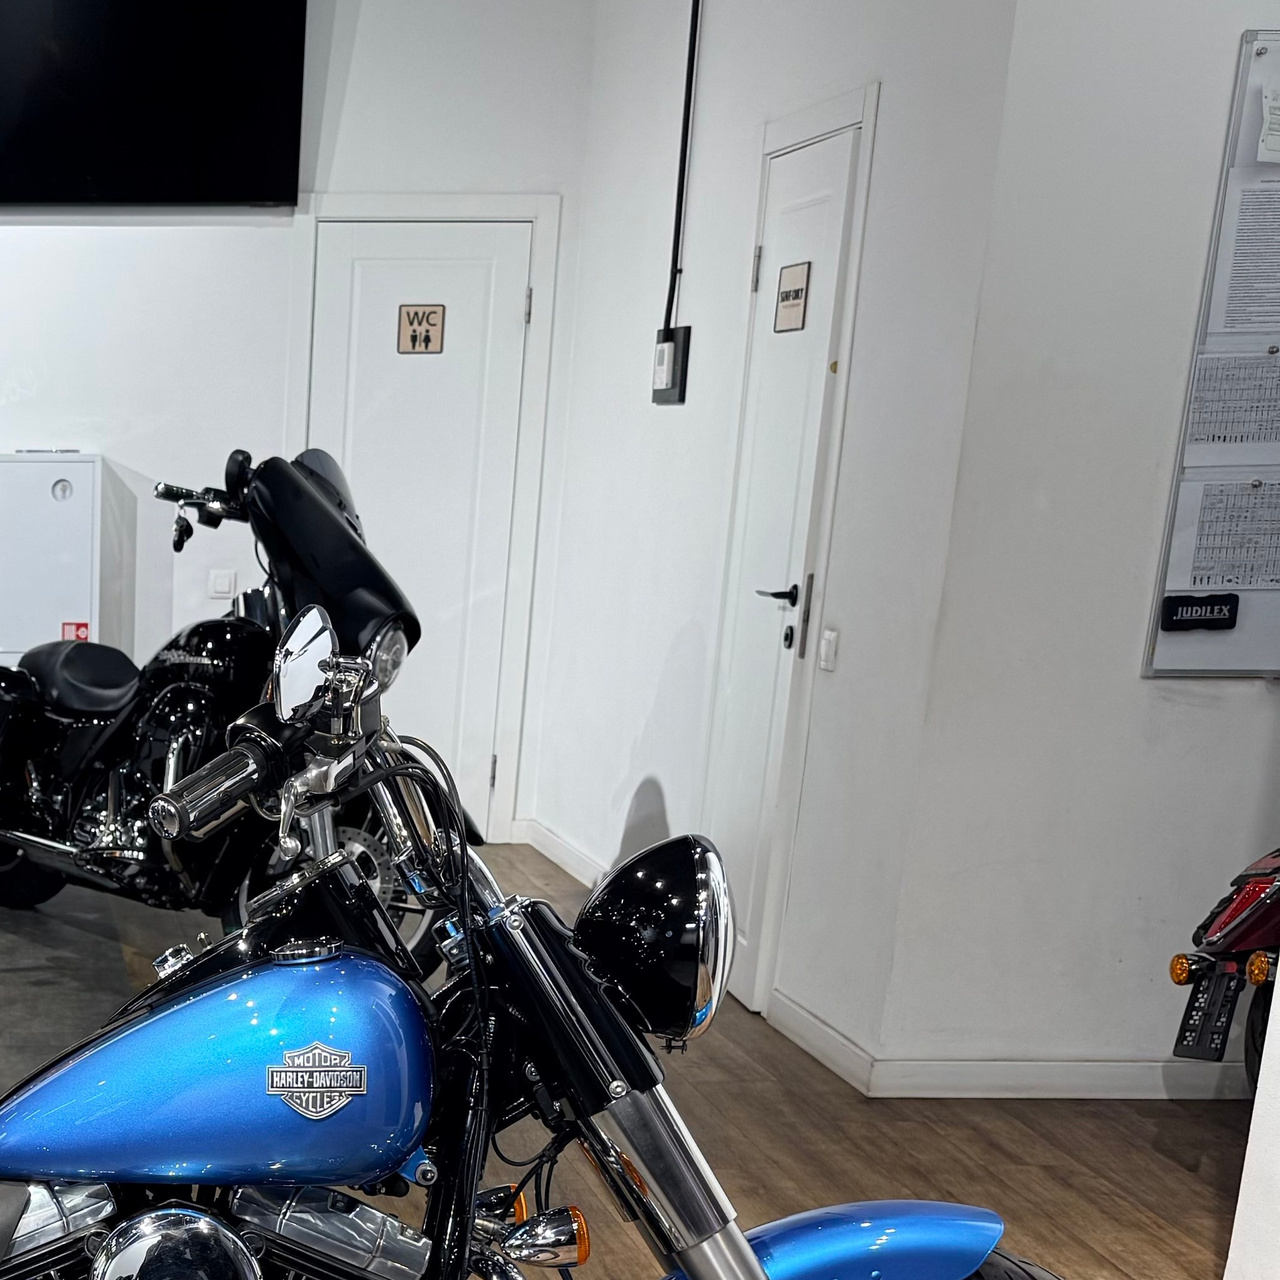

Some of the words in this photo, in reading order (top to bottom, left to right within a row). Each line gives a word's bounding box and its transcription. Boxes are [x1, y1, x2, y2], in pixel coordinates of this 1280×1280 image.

[406, 310, 438, 327] WC
[1173, 605, 1231, 620] JUDILEX
[294, 1048, 340, 1067] MOTOR
[273, 1071, 360, 1088] HARLEY-DAVIDSON
[293, 1092, 341, 1112] CYCLES
